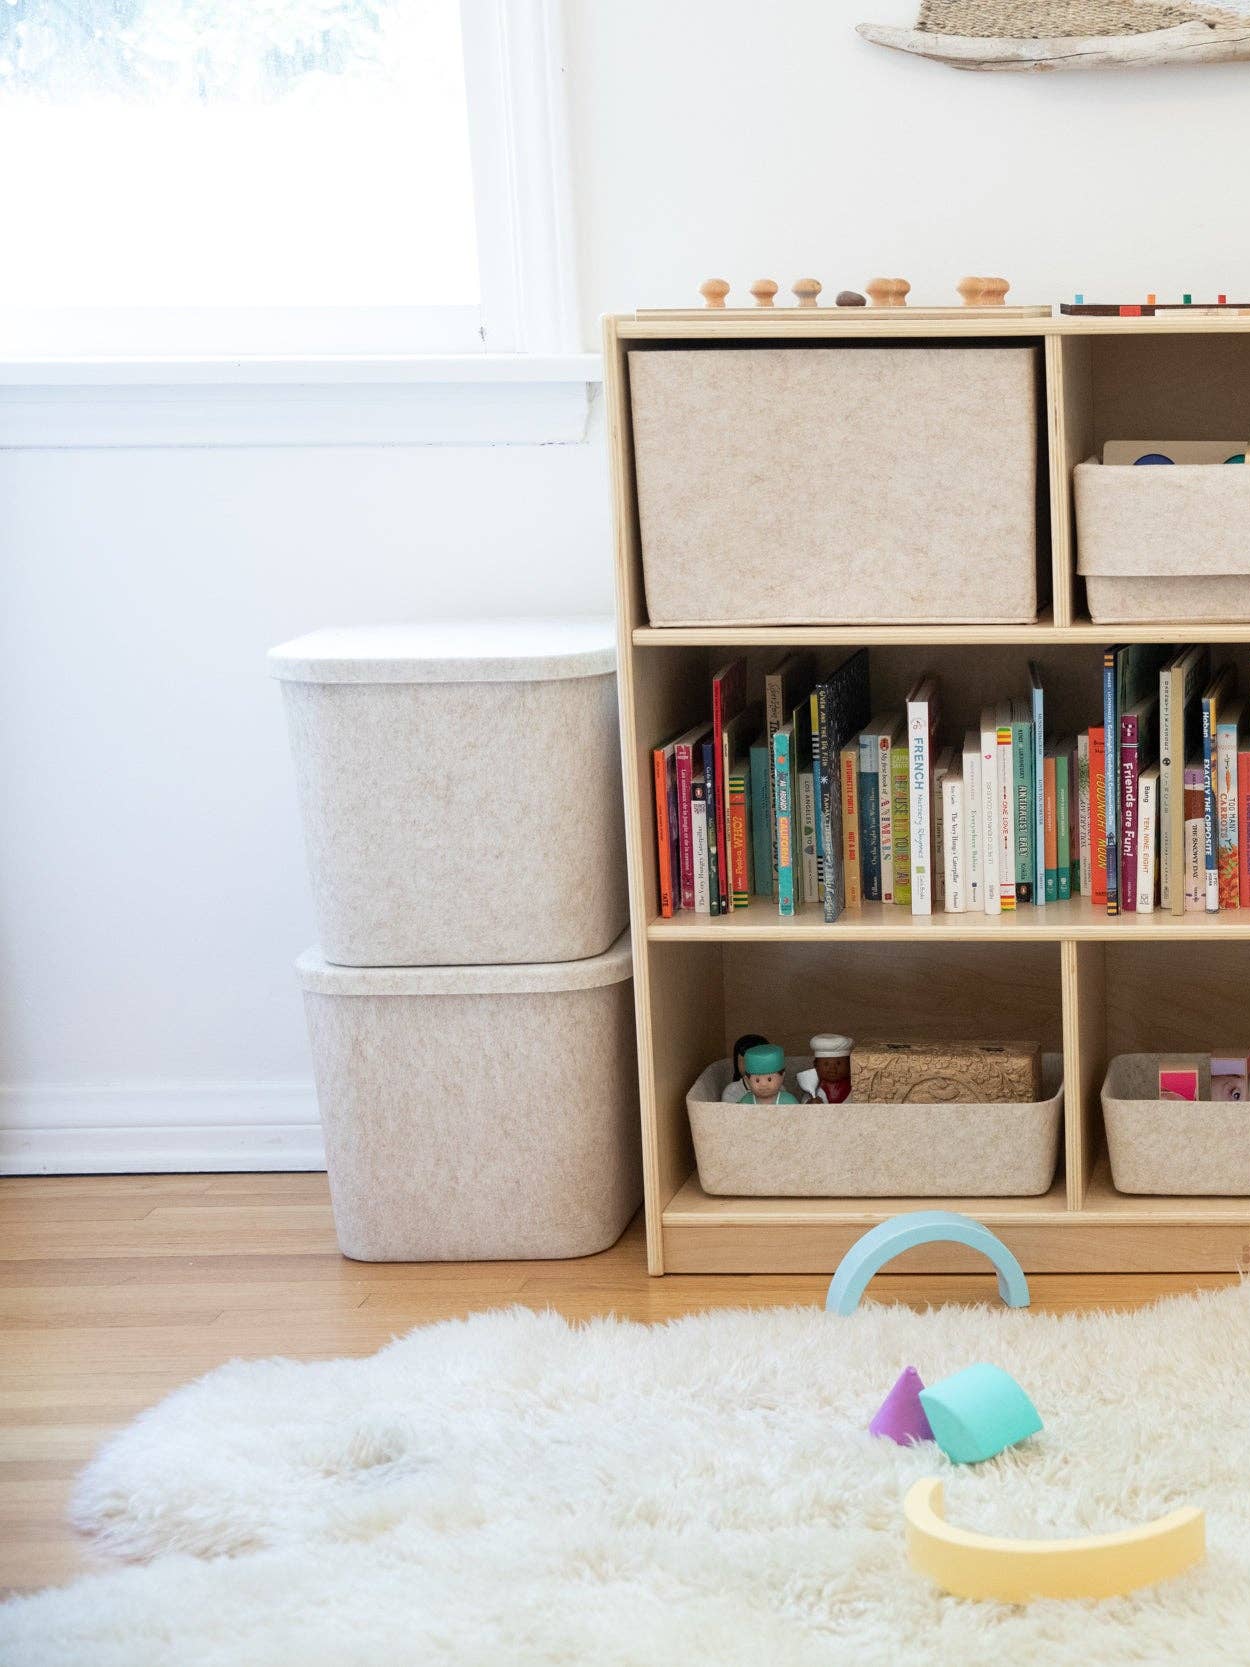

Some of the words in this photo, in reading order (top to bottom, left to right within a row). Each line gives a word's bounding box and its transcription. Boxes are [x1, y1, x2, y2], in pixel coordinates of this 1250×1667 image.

[1202, 711, 1210, 738] Hoban
[821, 752, 829, 767] FISH
[879, 752, 887, 761] My
[880, 762, 888, 773] first
[914, 737, 925, 790] FRENCH
[1123, 762, 1135, 808] Friends
[1203, 758, 1211, 795] EXACTLY
[804, 794, 812, 825] ANGELES
[894, 774, 909, 815] BECAUSE
[914, 794, 924, 825] Nursery
[1018, 785, 1028, 832] ANTIRACIST
[1096, 773, 1106, 833] GOODNIGHT
[1143, 785, 1151, 803] Bang
[1228, 797, 1236, 812] TOO
[881, 798, 892, 861] ANIMALS
[970, 810, 978, 848] Everywhere
[1126, 810, 1134, 827] are
[1220, 793, 1228, 839] CARROTS
[1229, 813, 1237, 832] MANY
[696, 826, 704, 856] Caterpillar
[780, 816, 790, 867] CALIFORNIA
[894, 836, 910, 861] YOUR
[915, 828, 925, 859] Rhymes
[1018, 836, 1028, 857] BABY
[1123, 830, 1135, 857] Fun!
[1204, 814, 1212, 856] OPPOSITE
[697, 858, 705, 879] Hungry
[1097, 837, 1107, 869] MOON
[697, 881, 705, 894] Very
